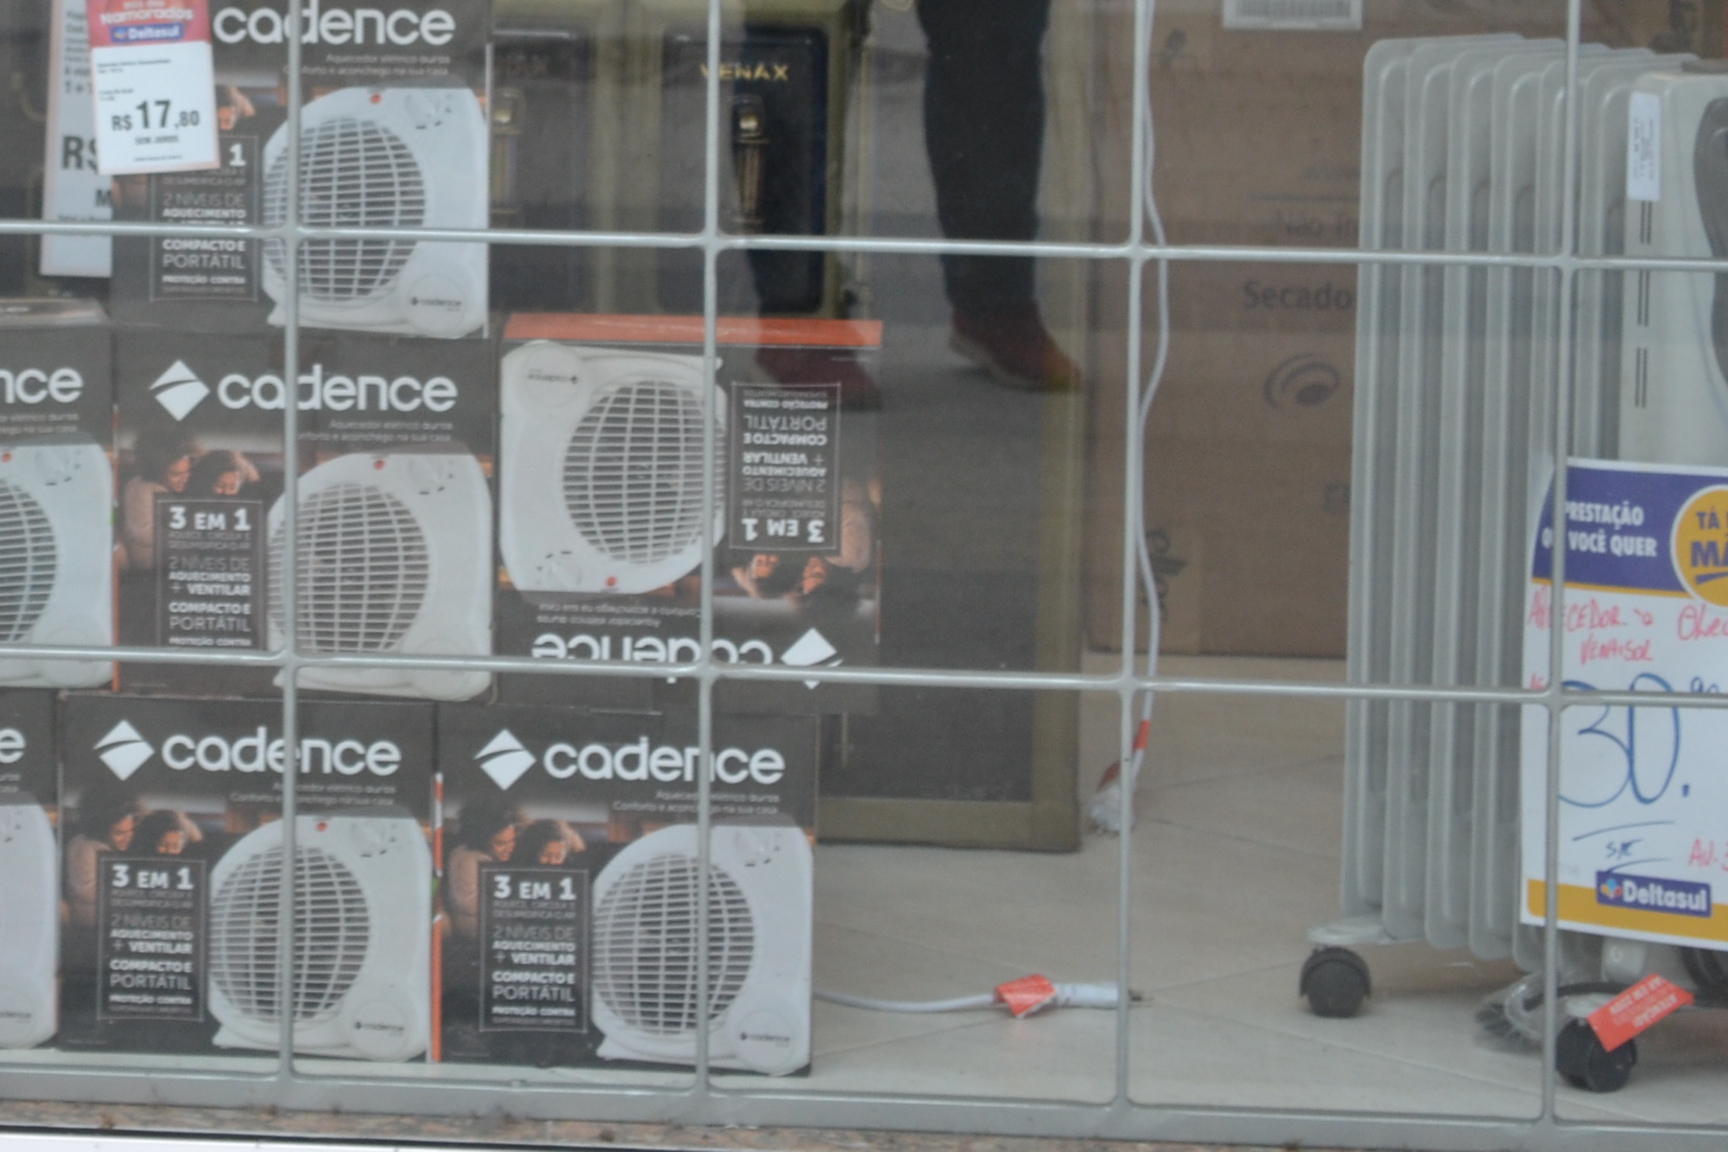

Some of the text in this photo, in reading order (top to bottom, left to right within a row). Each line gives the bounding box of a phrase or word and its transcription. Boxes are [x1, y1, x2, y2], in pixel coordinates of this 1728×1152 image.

[100, 7, 194, 24] Namorados
[127, 25, 180, 40] Deltasul
[112, 99, 200, 131] R$ 17,80
[229, 143, 246, 166] 1
[162, 208, 246, 219] AQUECIMENTO
[162, 240, 236, 251] COMPACTO
[163, 253, 246, 270] PORTÁTIL
[1242, 279, 1356, 311] Secado
[217, 364, 459, 413] cadence
[168, 505, 251, 530] 3 EM 1
[1565, 501, 1645, 531] PRESTAÇÃO
[1568, 529, 1607, 554] VOCÊ
[1610, 534, 1658, 558] QUER
[168, 571, 251, 582] AQUECIMENTO
[186, 583, 252, 596] VENTILAR
[168, 602, 242, 614] COMPACTO
[169, 615, 252, 632] PORTÁTIL
[161, 726, 402, 776] cadence
[544, 735, 786, 785] cadence
[111, 863, 194, 890] 3 EM 1
[493, 874, 576, 900] 3 EM 1
[1622, 879, 1708, 913] Deltasul
[110, 929, 193, 941] AQUECIMENTO
[128, 941, 193, 955] VENTILAR
[492, 940, 576, 952] AQUECIMENTO
[110, 959, 183, 973] COMPACTO
[510, 952, 576, 966] VENTILAR
[110, 972, 193, 991] PORTÁTIL
[492, 971, 566, 984] COMPACTO
[493, 984, 576, 1002] PORTÁTIL
